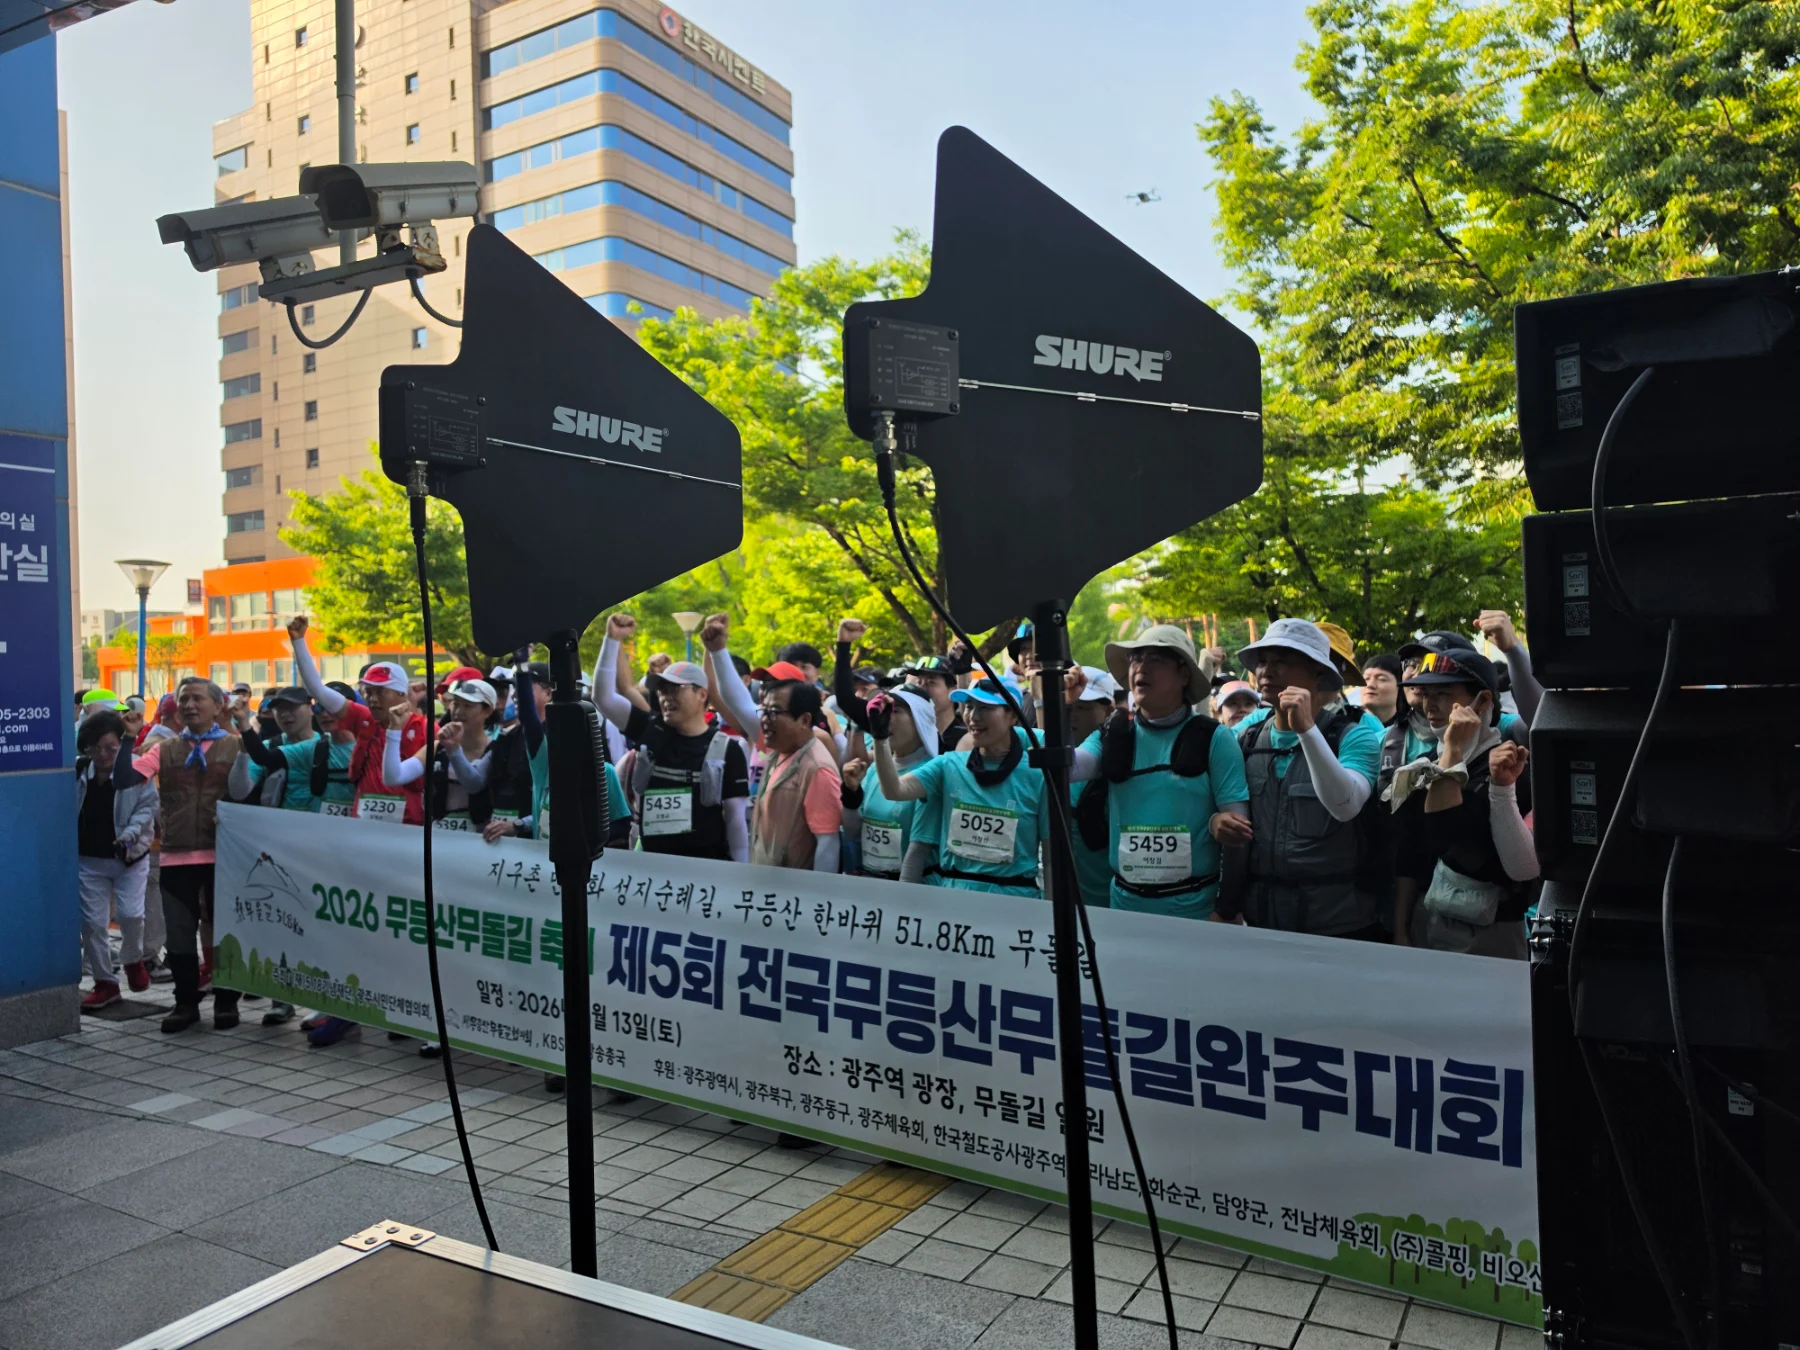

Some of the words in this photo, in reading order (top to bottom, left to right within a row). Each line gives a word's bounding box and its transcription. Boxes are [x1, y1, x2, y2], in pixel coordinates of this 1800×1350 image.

[1033, 334, 1164, 383] SHURE
[552, 405, 663, 454] SHURE
[326, 804, 353, 818] 524
[363, 800, 396, 814] 5230
[645, 796, 682, 812] 5435
[959, 812, 1005, 836] 5052
[1128, 835, 1178, 853] 5459
[311, 882, 380, 933] 2026
[386, 895, 533, 966] 무등산무돌길
[488, 858, 541, 893] 지구촌
[613, 872, 722, 920] 성지순례길,
[733, 890, 803, 932] 무등산
[812, 901, 884, 944] 한바퀴
[895, 914, 996, 960] 51.8Km
[476, 979, 504, 1009] 일정
[611, 1009, 683, 1049] 13일(토)
[606, 922, 728, 1011] 제5회
[737, 943, 1525, 1169] 전국무등산무돌길완주대회
[782, 1044, 823, 1079] 장소
[841, 1057, 905, 1101] 광주역
[912, 1074, 966, 1116] 광장,
[973, 1085, 1047, 1131] 무돌길
[653, 1057, 676, 1081] 후원
[683, 1065, 743, 1099] 광주광역시,
[745, 1080, 797, 1112] 광주북구,
[799, 1091, 854, 1127] 광주동구,
[857, 1106, 930, 1145] 광주체육회,
[1147, 1176, 1206, 1214] 화순군,
[1212, 1192, 1275, 1230] 담양군,
[1280, 1206, 1386, 1258] 전남체육회,
[1393, 1230, 1474, 1279] (주)콜핑,
